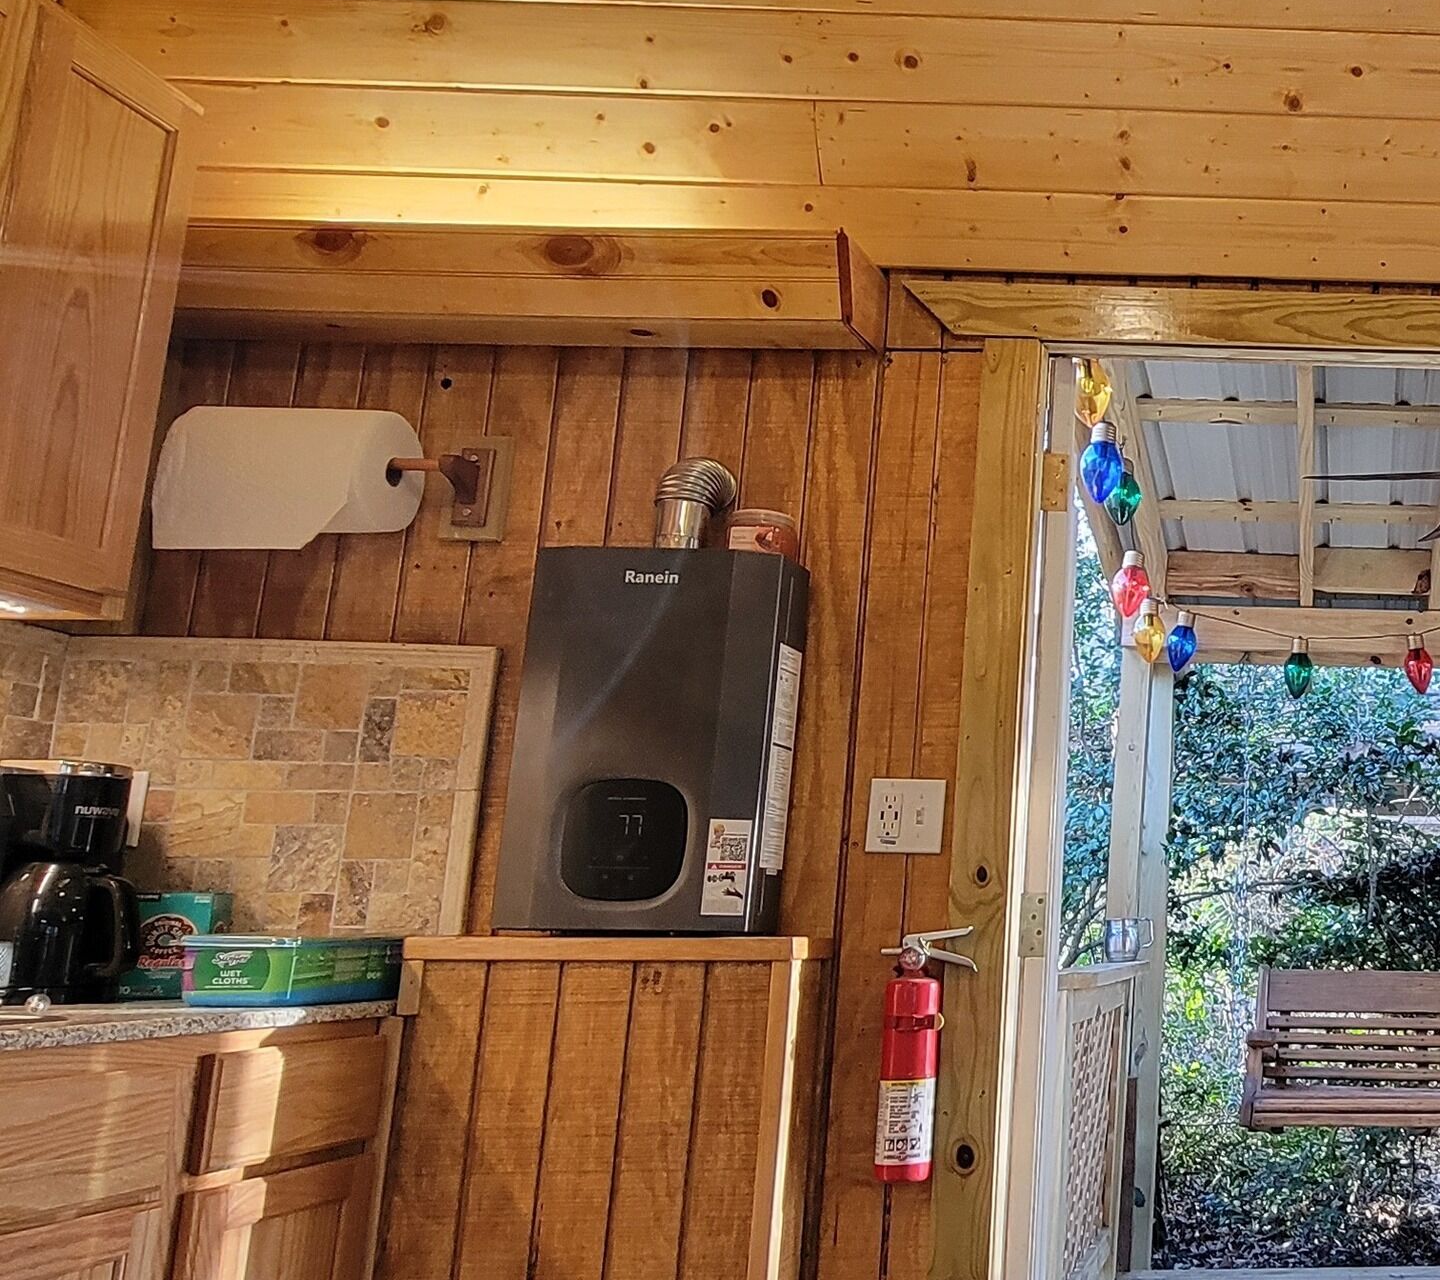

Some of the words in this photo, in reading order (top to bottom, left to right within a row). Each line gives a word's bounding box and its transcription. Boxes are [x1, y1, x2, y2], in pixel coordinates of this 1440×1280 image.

[624, 570, 679, 584] Ranein
[619, 814, 643, 835] 77
[219, 969, 243, 977] WET
[211, 977, 250, 985] CLOTHS
